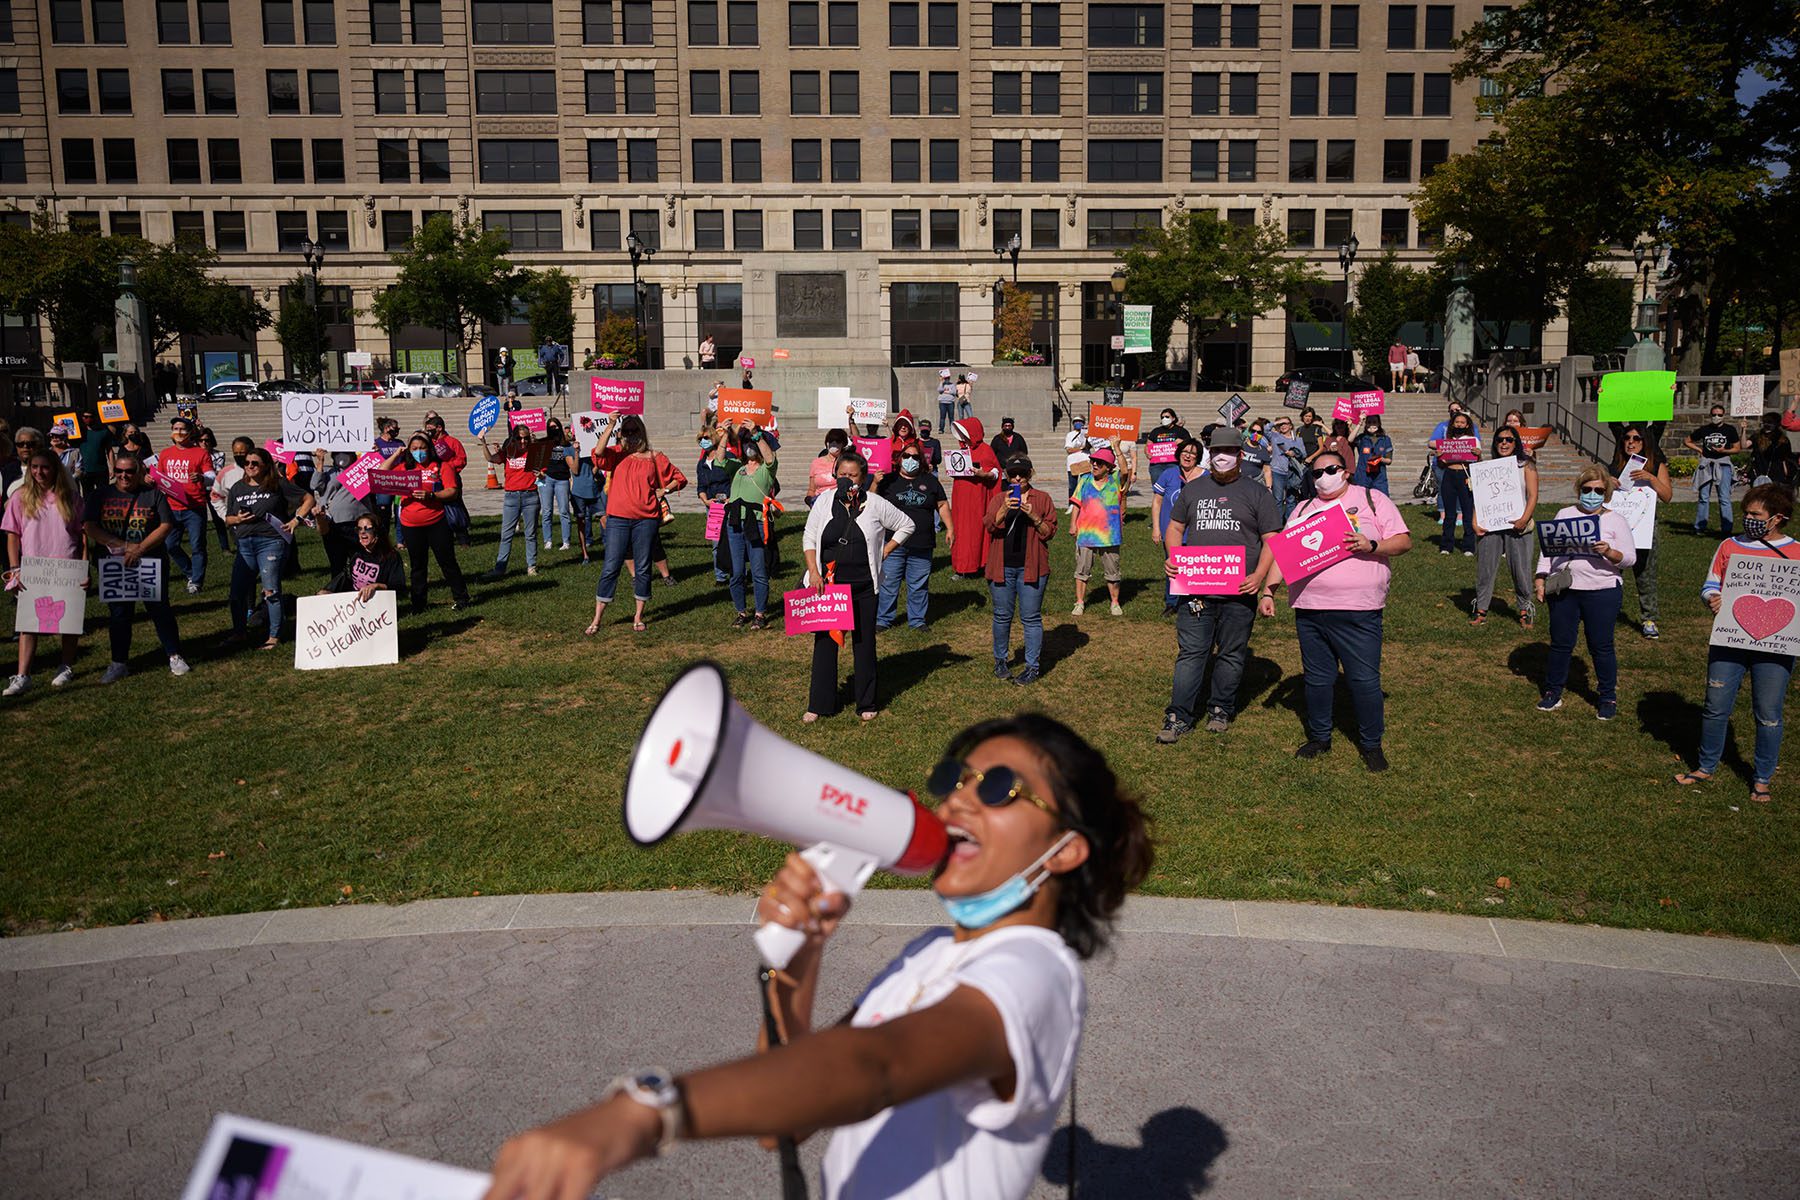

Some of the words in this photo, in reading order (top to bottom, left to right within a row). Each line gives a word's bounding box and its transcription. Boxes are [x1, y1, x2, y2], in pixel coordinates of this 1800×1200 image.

[412, 362, 442, 371] SPACE
[594, 383, 627, 394] Together
[596, 392, 614, 401] Fight
[286, 396, 334, 421] GOP
[304, 415, 345, 428] ANTI
[286, 428, 368, 444] WOMAN!
[346, 456, 372, 478] PROTECT
[346, 473, 363, 486] SAFE,
[372, 472, 406, 480] Together
[1197, 499, 1218, 509] REAL
[1196, 508, 1214, 520] MEN
[1215, 508, 1232, 520] ARE
[1196, 520, 1240, 532] FEMINISTS
[1286, 526, 1306, 539] REPRO
[1306, 516, 1327, 530] RIGHTS
[1540, 520, 1596, 538] PAID
[1543, 536, 1596, 548] LEAVE
[1318, 544, 1341, 558] RIGHTS
[1175, 554, 1222, 565] Together
[1224, 554, 1241, 563] We
[355, 561, 378, 578] 1973
[1178, 566, 1204, 577] Fight
[1206, 566, 1222, 575] for
[1224, 566, 1240, 575] All
[1737, 561, 1764, 572] OUR
[103, 561, 122, 600] PAID
[141, 562, 156, 586] ALL
[1730, 572, 1764, 580] BEGIN
[1770, 575, 1784, 584] TO
[141, 587, 152, 598] for
[1750, 589, 1784, 597] SILENT
[788, 592, 831, 608] Together
[832, 592, 848, 601] We
[791, 606, 816, 618] Fight
[816, 604, 831, 612] for
[833, 603, 848, 612] All
[306, 597, 366, 642] Abortion
[1715, 626, 1739, 634] ABOUT
[1726, 636, 1746, 644] THAT
[1749, 640, 1788, 650] MATTER
[306, 645, 322, 660] is
[820, 783, 868, 816] PYLE
